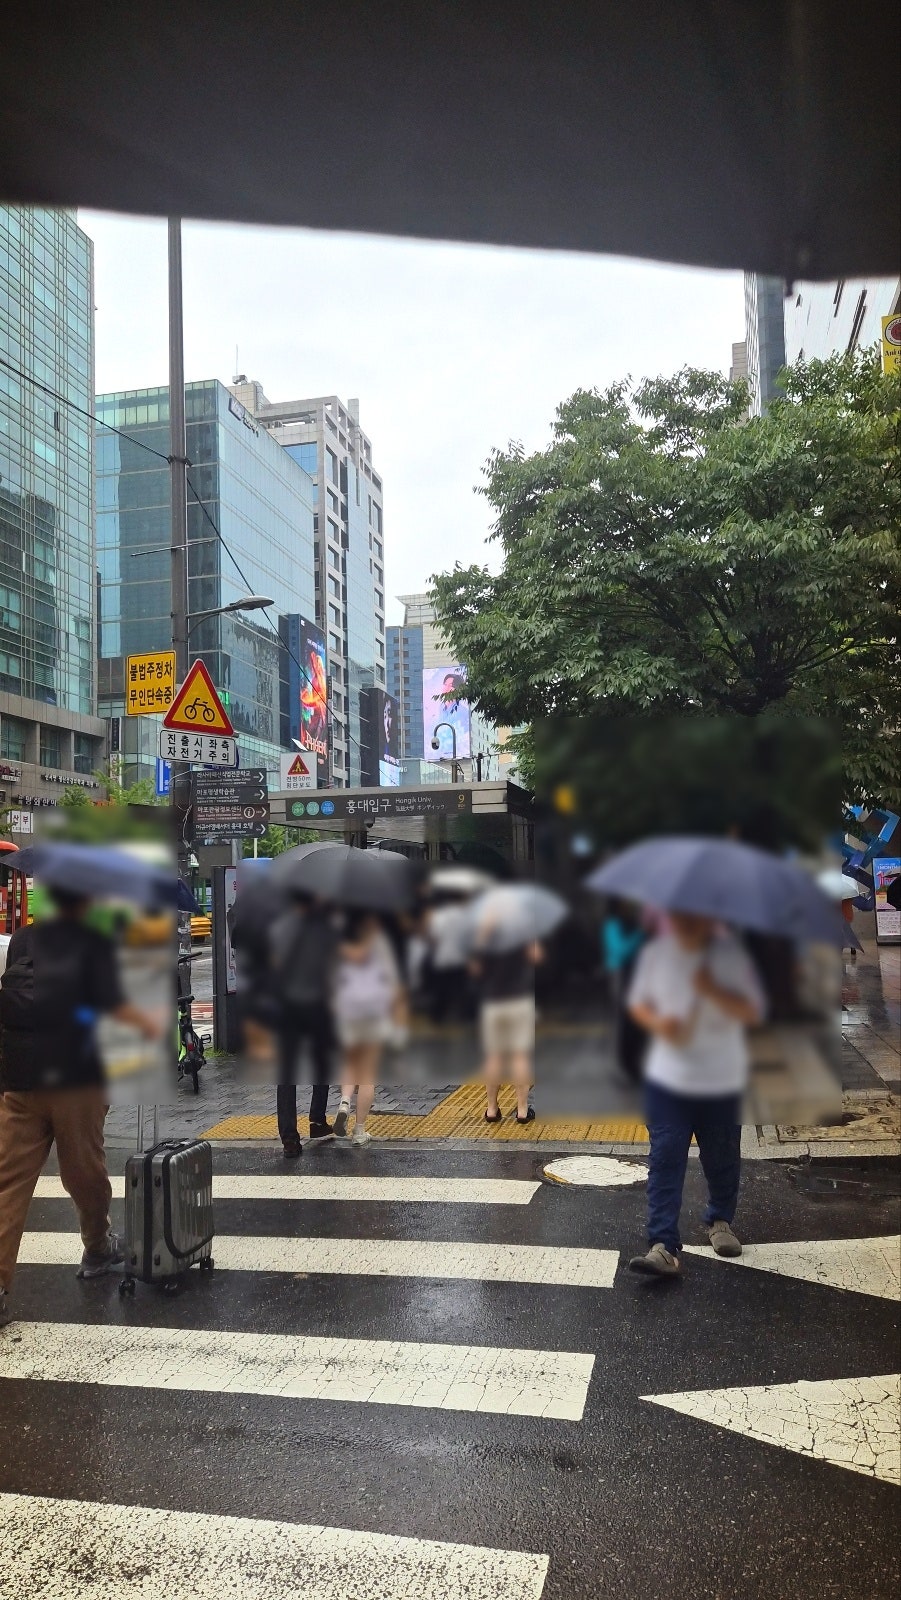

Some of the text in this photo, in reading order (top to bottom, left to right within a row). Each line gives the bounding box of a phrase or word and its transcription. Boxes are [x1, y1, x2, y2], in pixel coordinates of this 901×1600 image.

[130, 660, 172, 681] 불법주정차
[130, 686, 172, 707] 무인단속중
[346, 799, 392, 814] 홍대입구
[459, 794, 465, 803] 9
